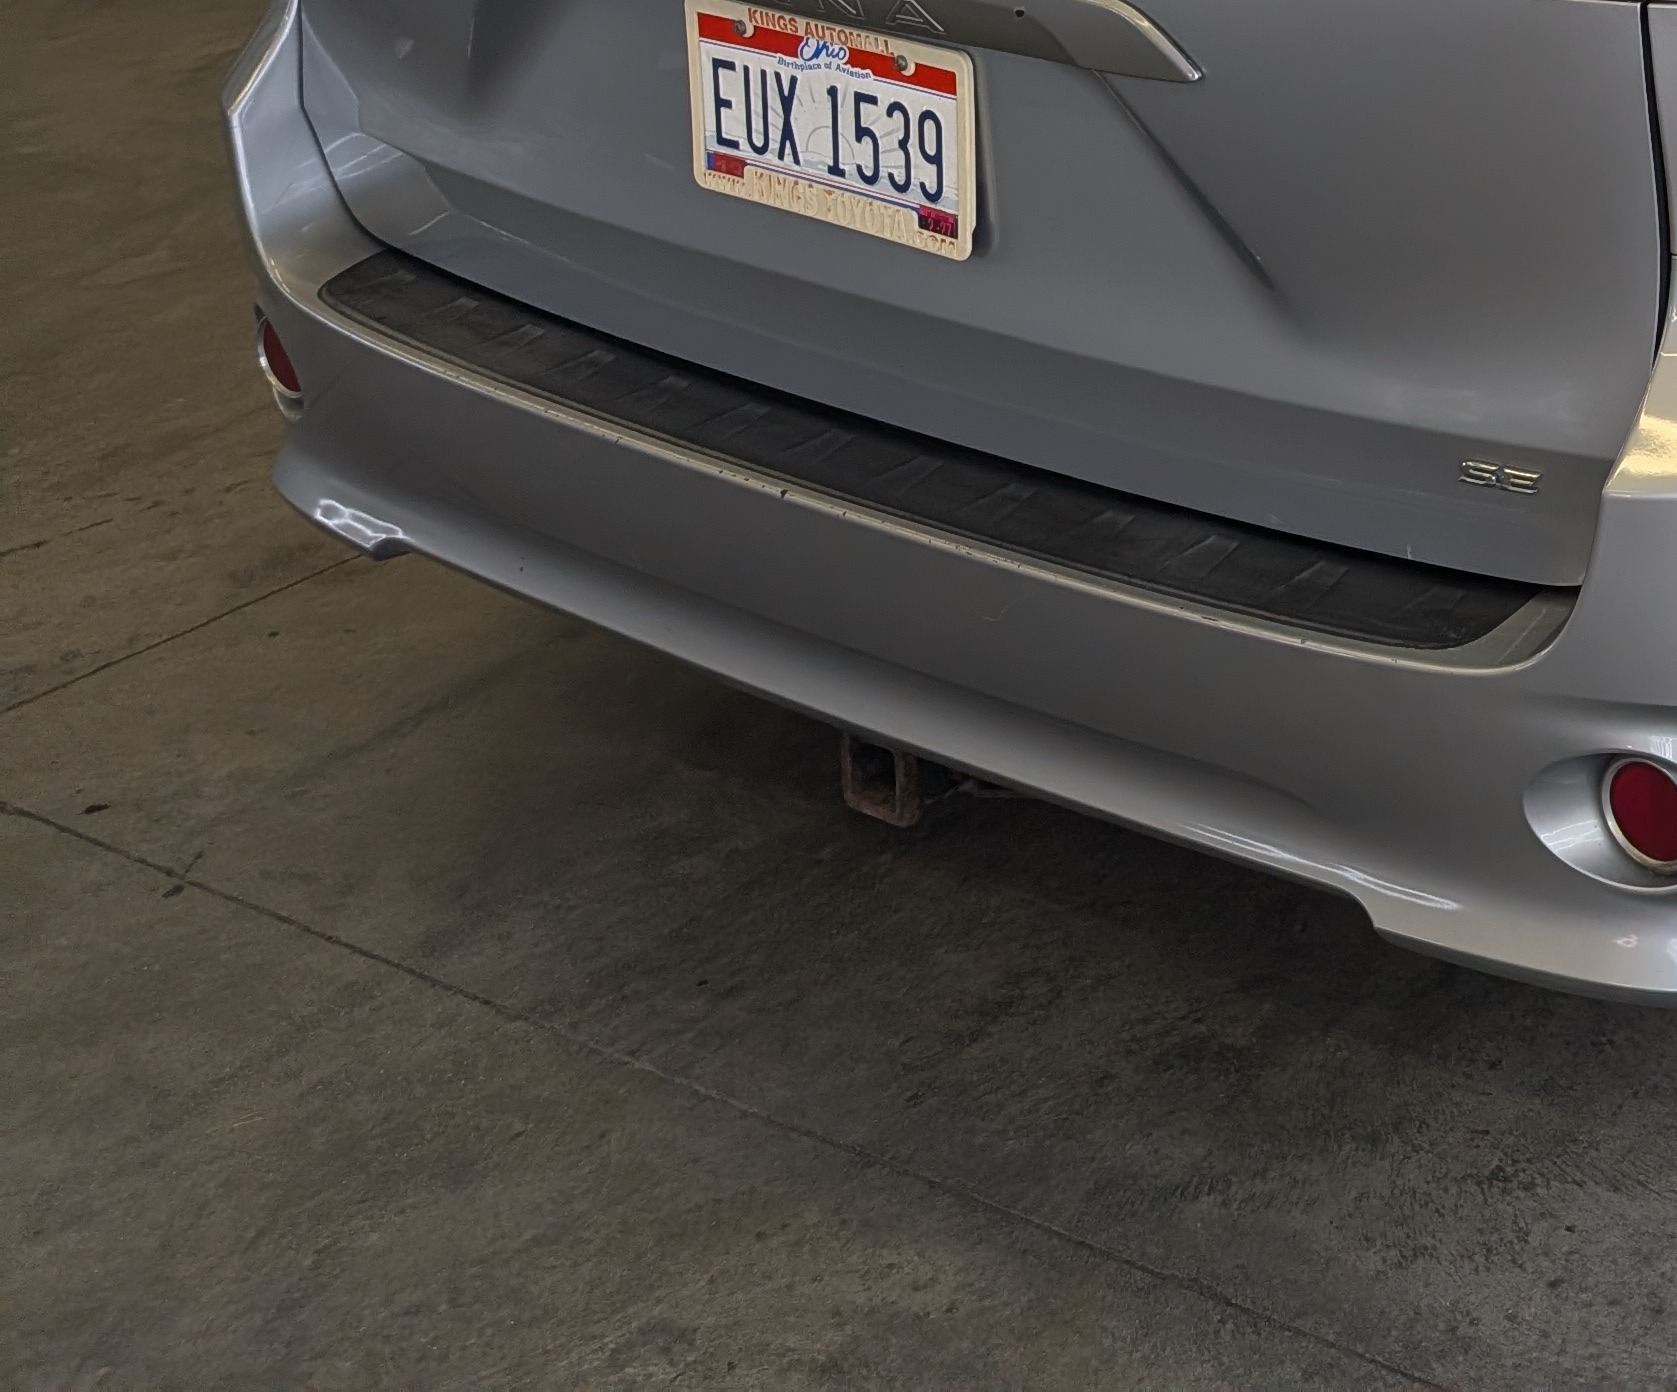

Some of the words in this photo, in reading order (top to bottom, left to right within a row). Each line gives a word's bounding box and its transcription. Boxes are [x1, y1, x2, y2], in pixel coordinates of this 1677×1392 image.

[748, 7, 799, 34] KINGS
[804, 21, 895, 57] AUTOMALL
[800, 37, 847, 62] Ohio
[777, 57, 822, 72] Birthplace
[824, 61, 832, 70] of
[835, 64, 872, 80] Aviation
[712, 57, 800, 166] EUX
[827, 85, 943, 203] 1539
[1458, 458, 1543, 495] SE
